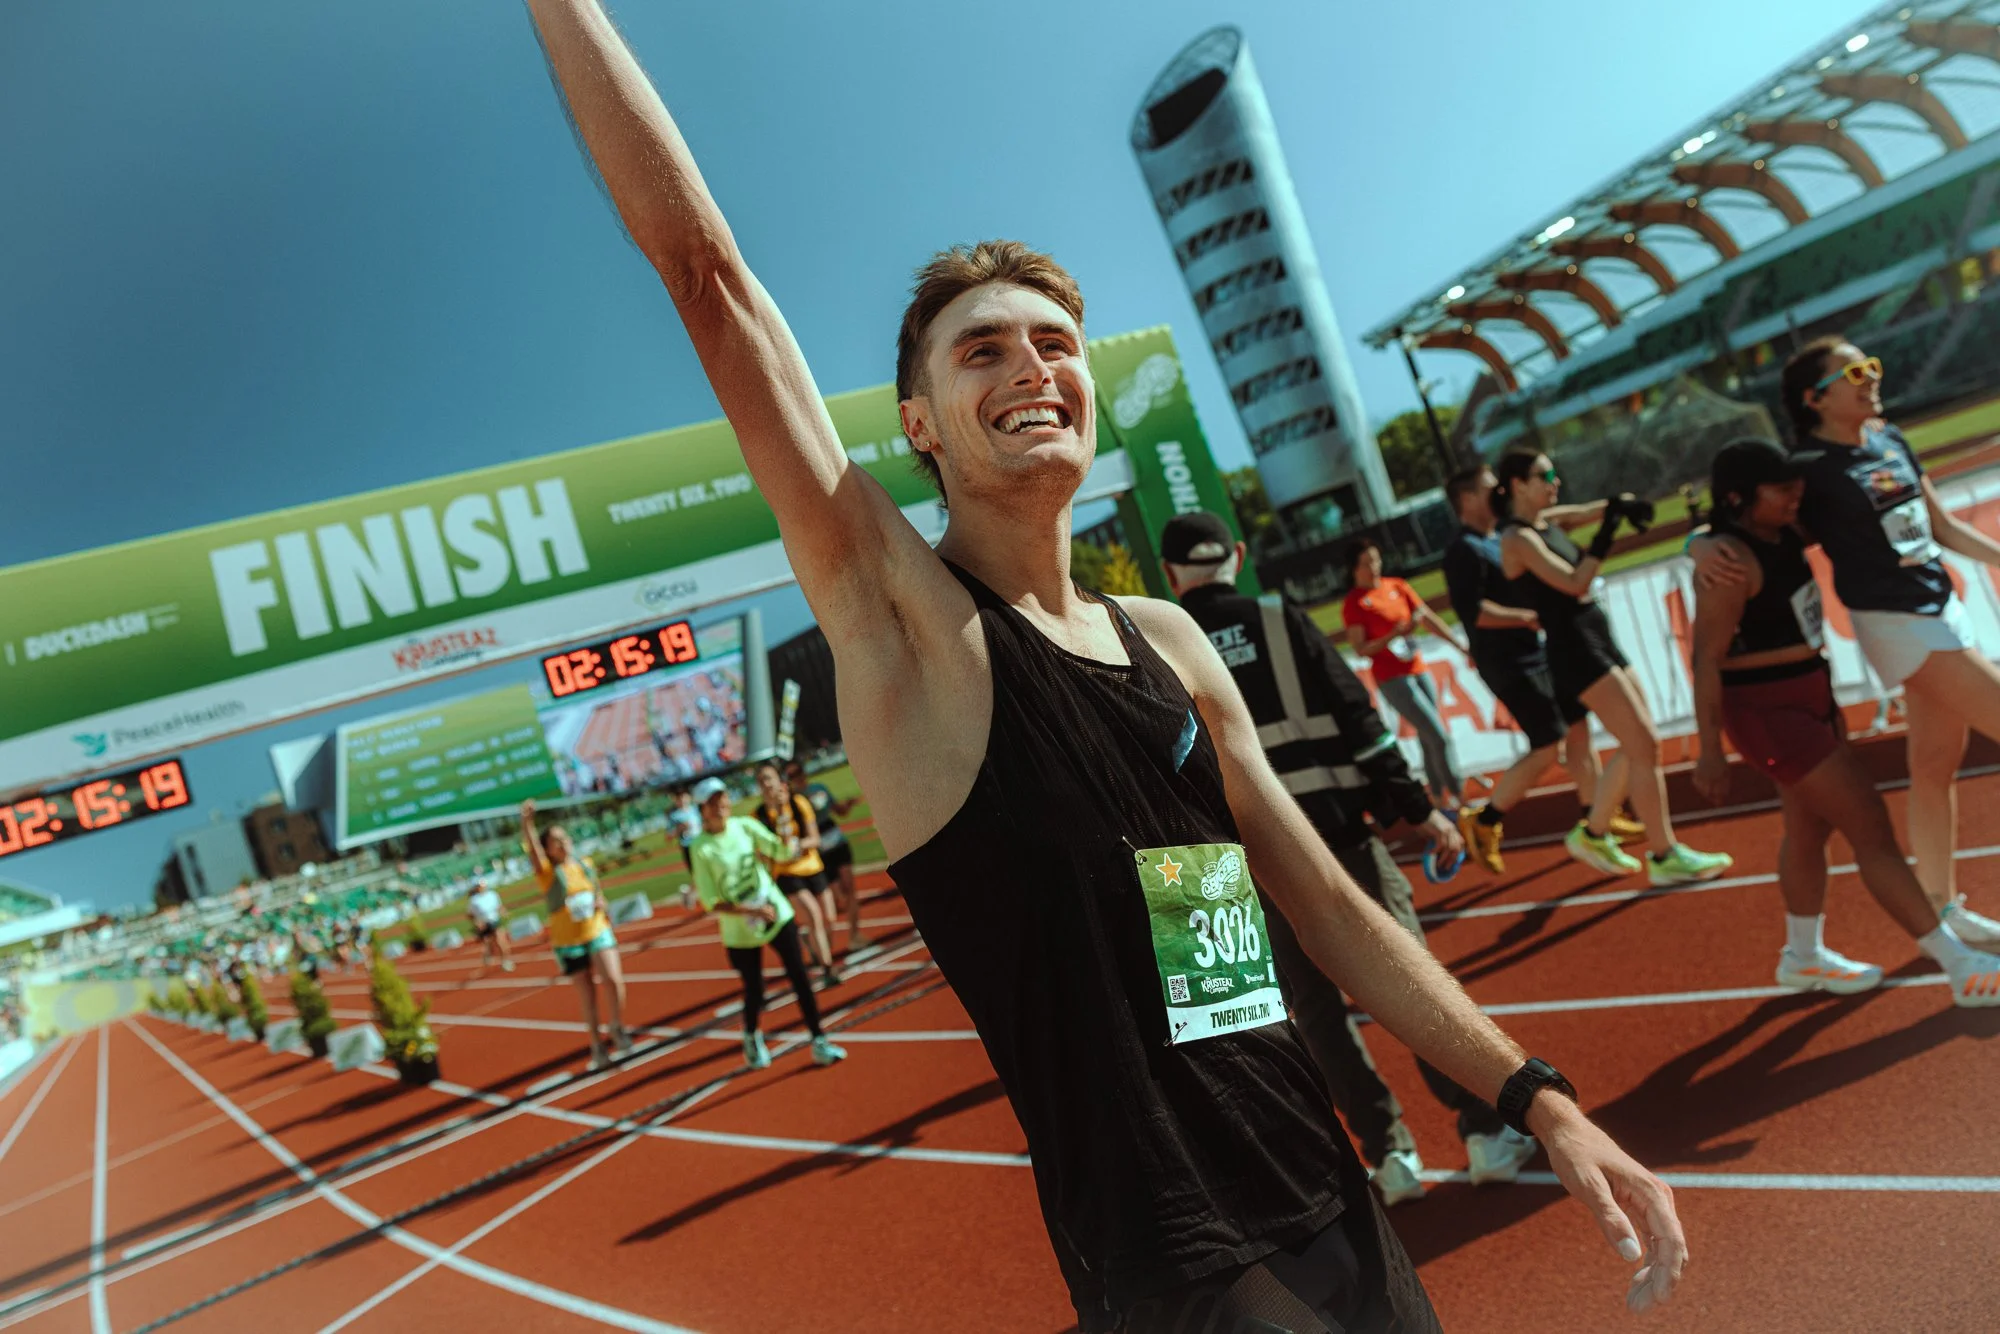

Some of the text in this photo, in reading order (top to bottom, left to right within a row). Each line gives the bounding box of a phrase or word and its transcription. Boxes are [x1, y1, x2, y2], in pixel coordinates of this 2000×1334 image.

[208, 478, 590, 657] FINISH
[543, 621, 699, 698] 02:15:19
[1188, 905, 1261, 968] 3026
[1210, 1006, 1247, 1028] TWENTY
